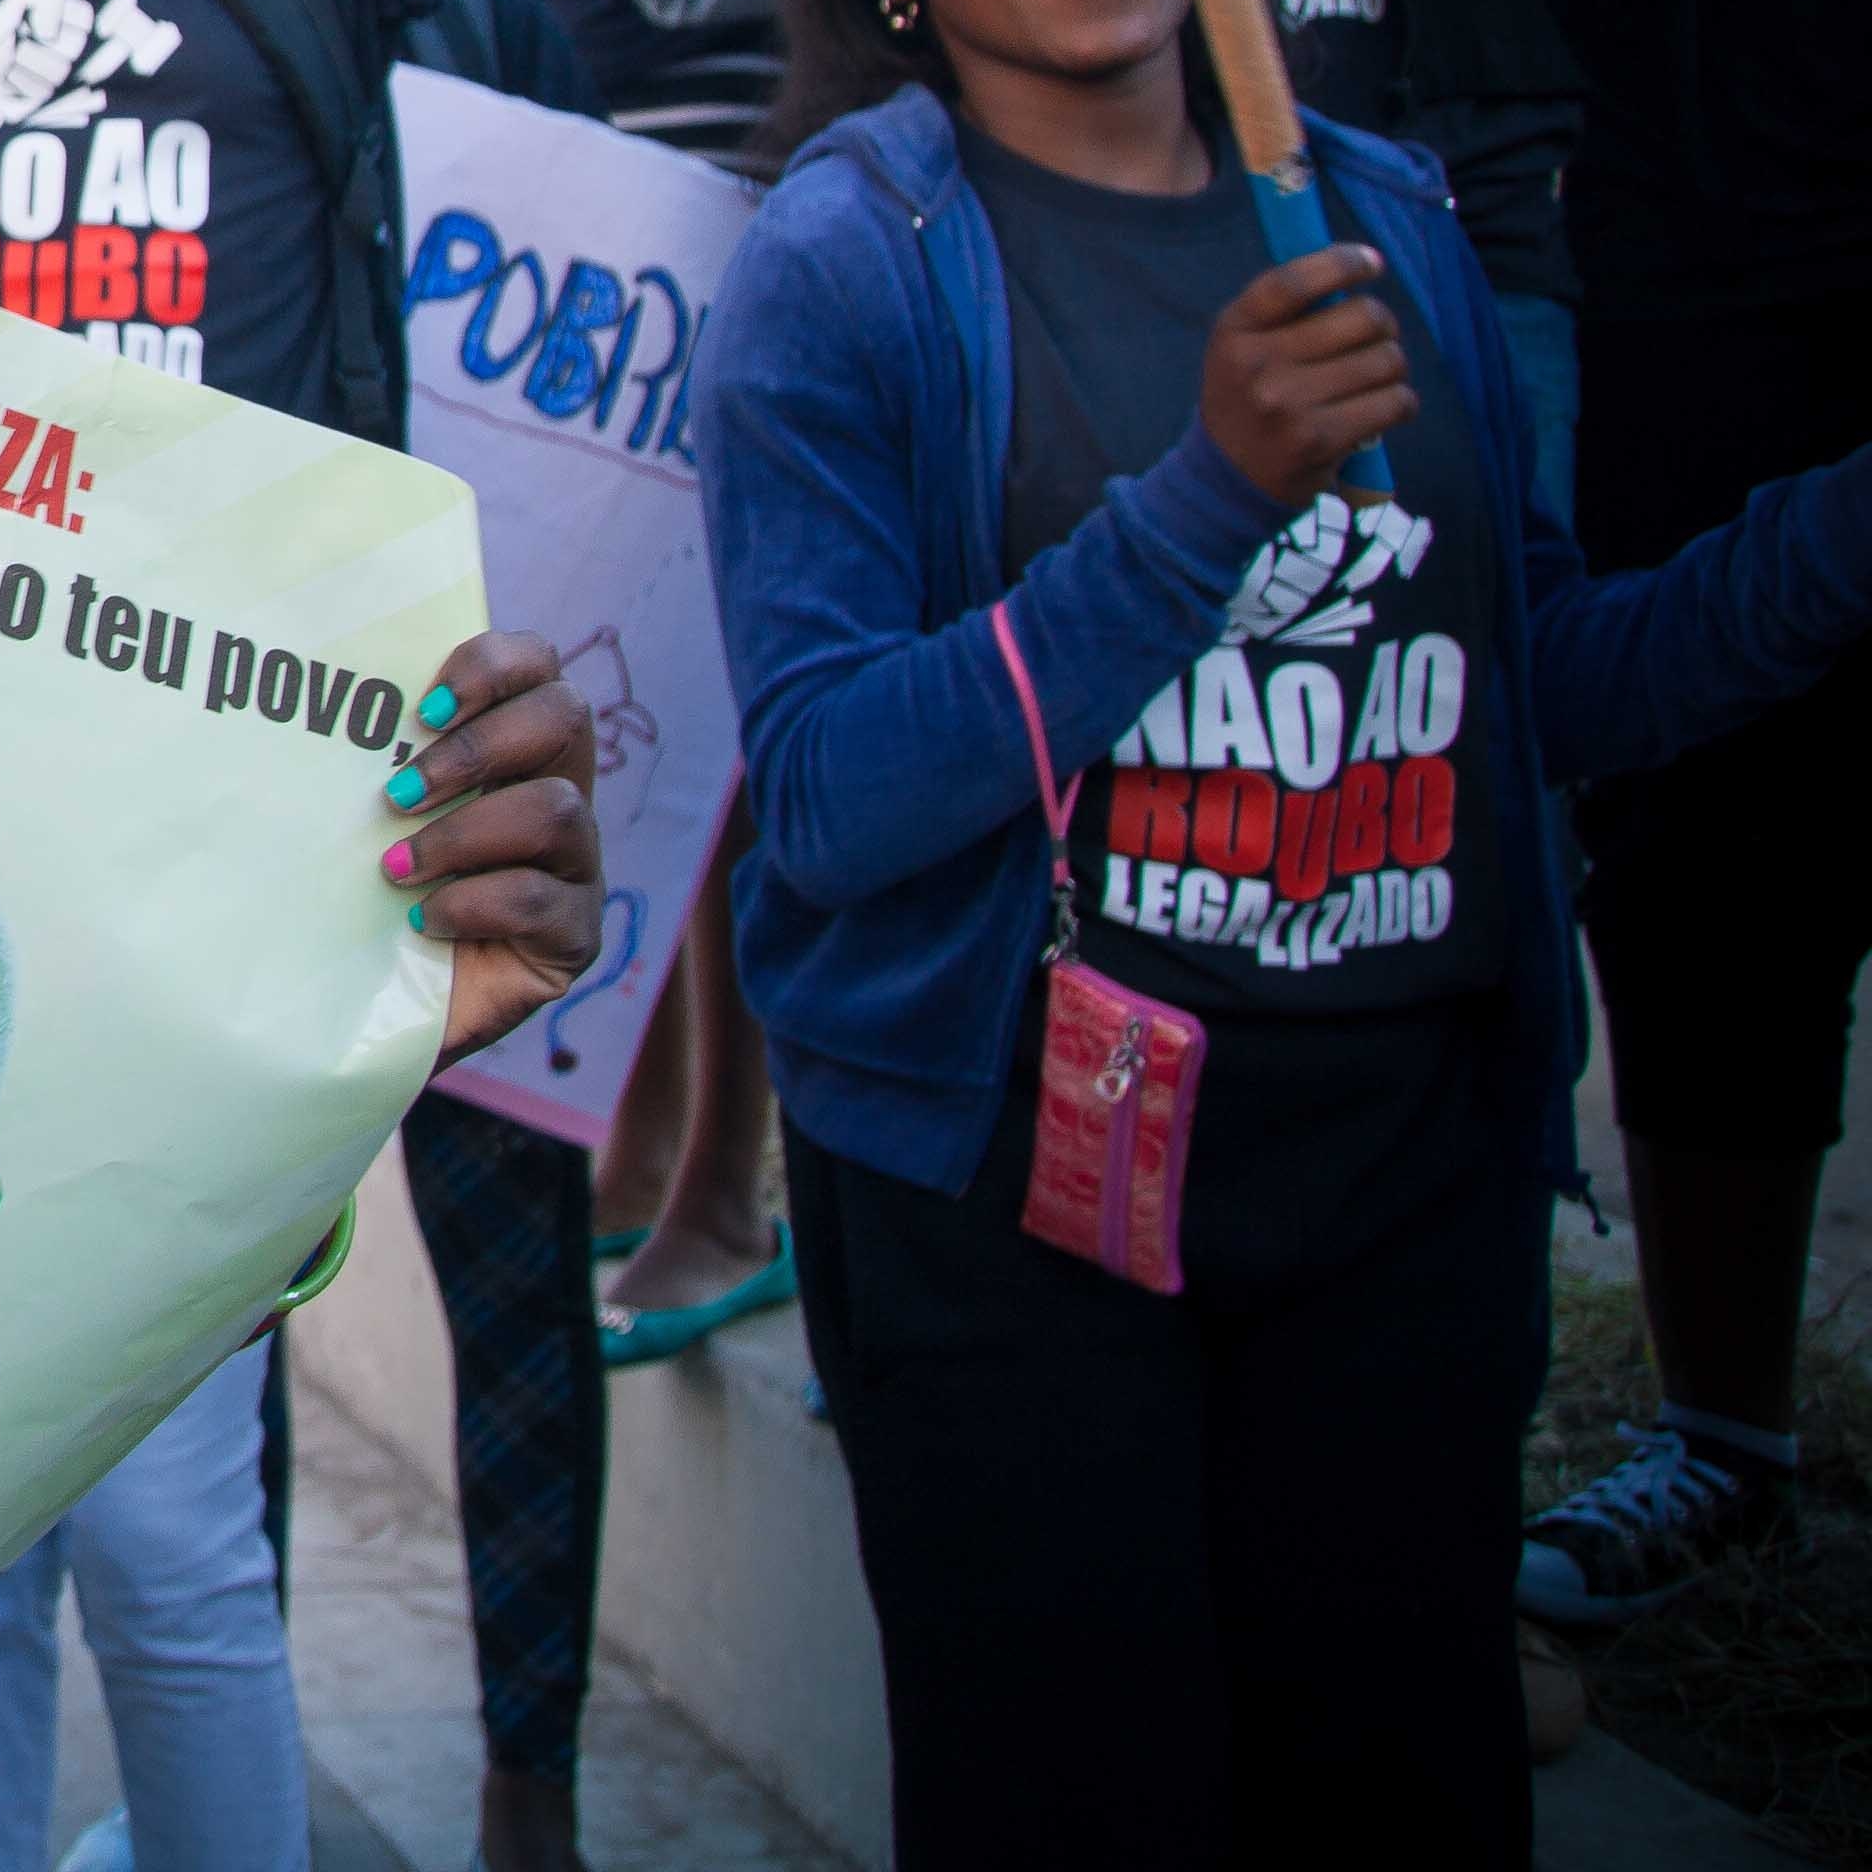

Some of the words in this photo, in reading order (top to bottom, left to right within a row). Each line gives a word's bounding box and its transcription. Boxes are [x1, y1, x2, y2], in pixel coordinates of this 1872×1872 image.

[77, 118, 212, 232] AO
[404, 208, 696, 463] POBR
[61, 570, 194, 694] teu
[205, 633, 416, 768] povo,
[1350, 632, 1466, 764] AO
[1108, 754, 1455, 903] ROUBO
[1101, 853, 1454, 971] LEGALIZADO
